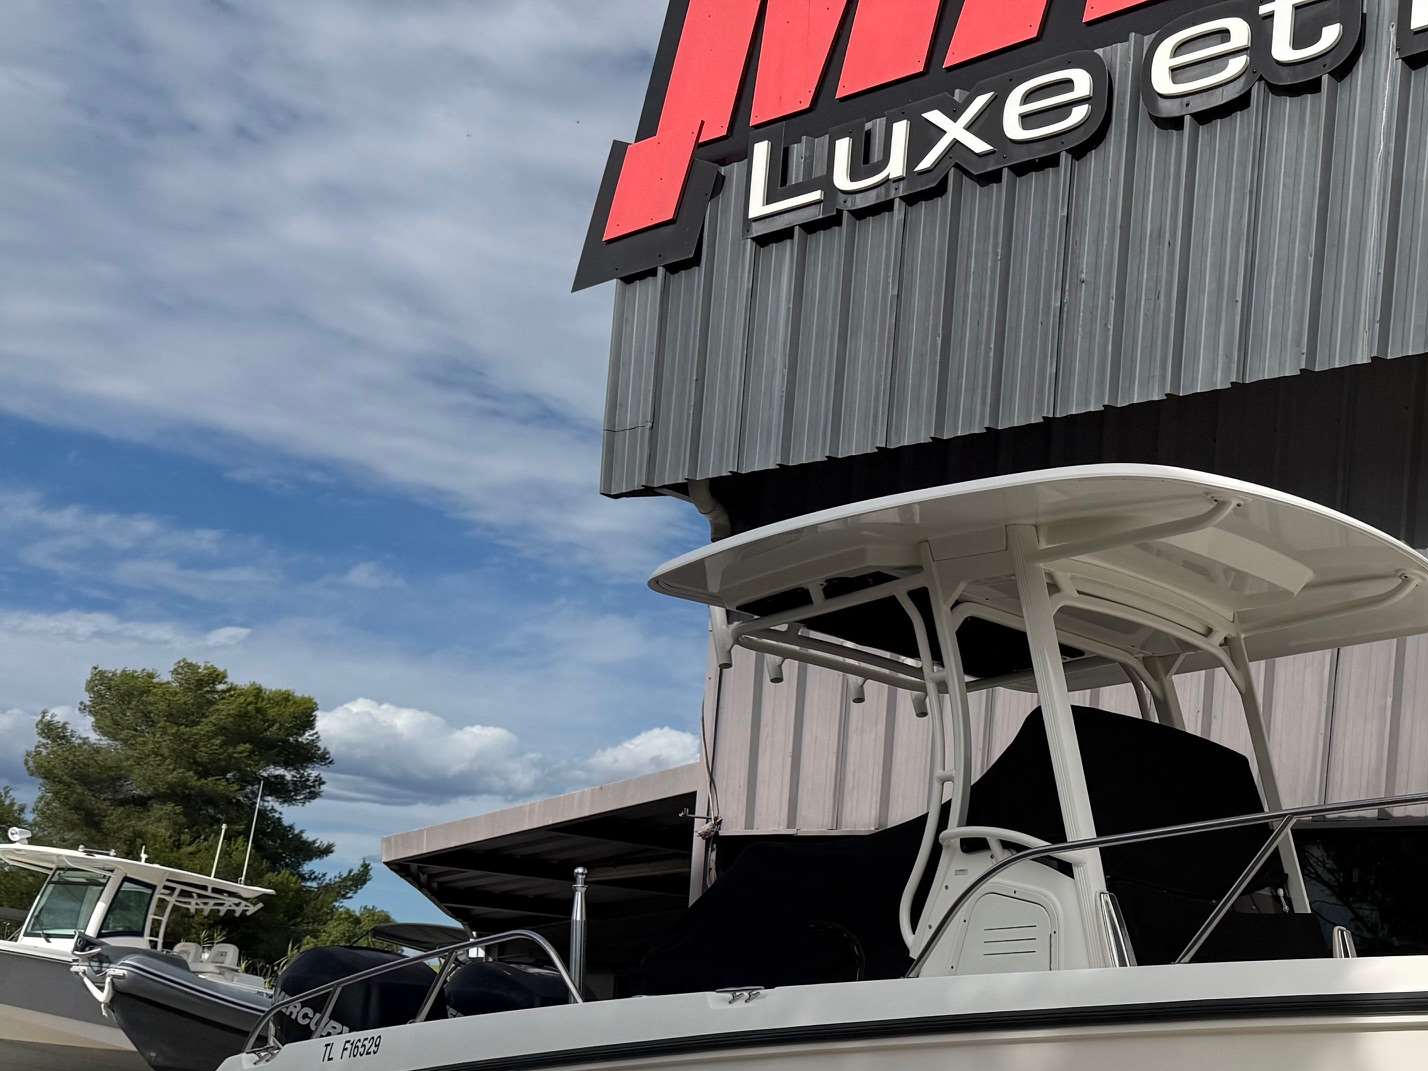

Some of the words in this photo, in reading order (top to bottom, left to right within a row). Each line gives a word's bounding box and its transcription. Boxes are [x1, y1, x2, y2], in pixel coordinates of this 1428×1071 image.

[748, 68, 1094, 221] Luxe
[1151, 0, 1343, 96] et
[273, 984, 350, 1036] RCUR
[322, 1042, 334, 1062] TL
[340, 1035, 382, 1060] F16529
